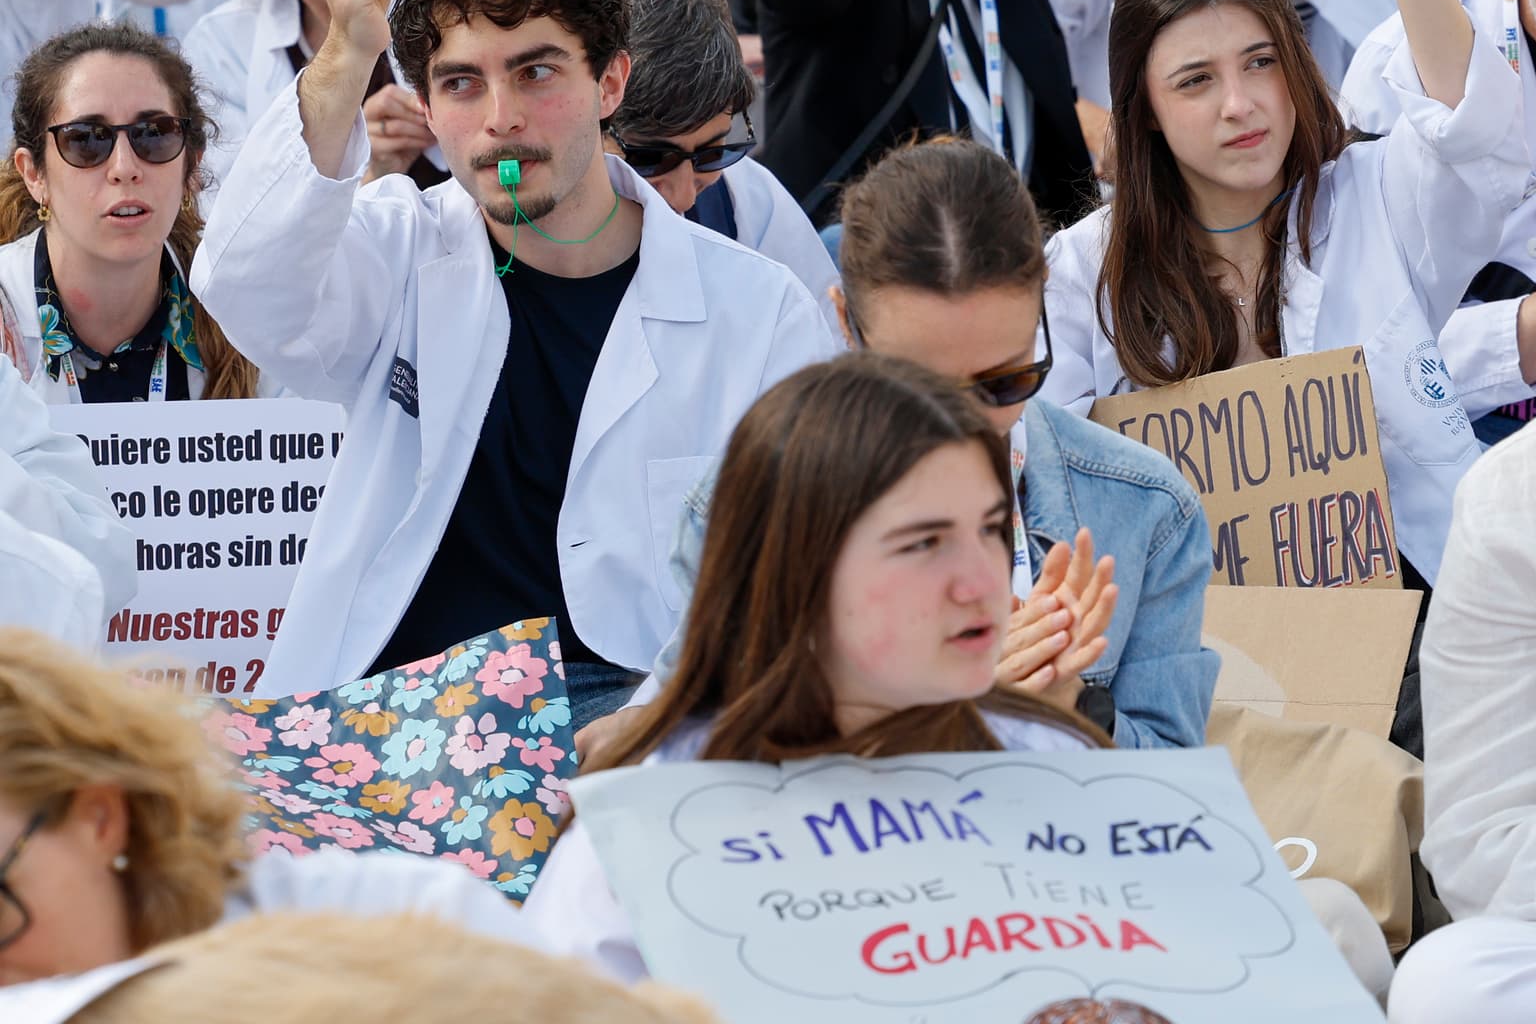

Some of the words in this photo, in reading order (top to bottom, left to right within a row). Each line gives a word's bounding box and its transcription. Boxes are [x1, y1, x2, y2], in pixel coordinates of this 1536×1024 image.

[1284, 350, 1368, 477] AQUÍ
[178, 429, 262, 463] usted
[270, 432, 324, 463] que
[153, 485, 181, 517] le
[188, 485, 275, 518] opere
[136, 539, 221, 571] horas
[228, 535, 272, 567] sin
[1269, 488, 1397, 589] FUERA
[107, 608, 259, 643] Nuestras
[196, 661, 237, 695] de
[802, 789, 994, 858] MAMÁ
[1108, 814, 1214, 858] ESTÁ
[758, 878, 958, 923] PORQUE
[860, 911, 1169, 976] GUARDIA
